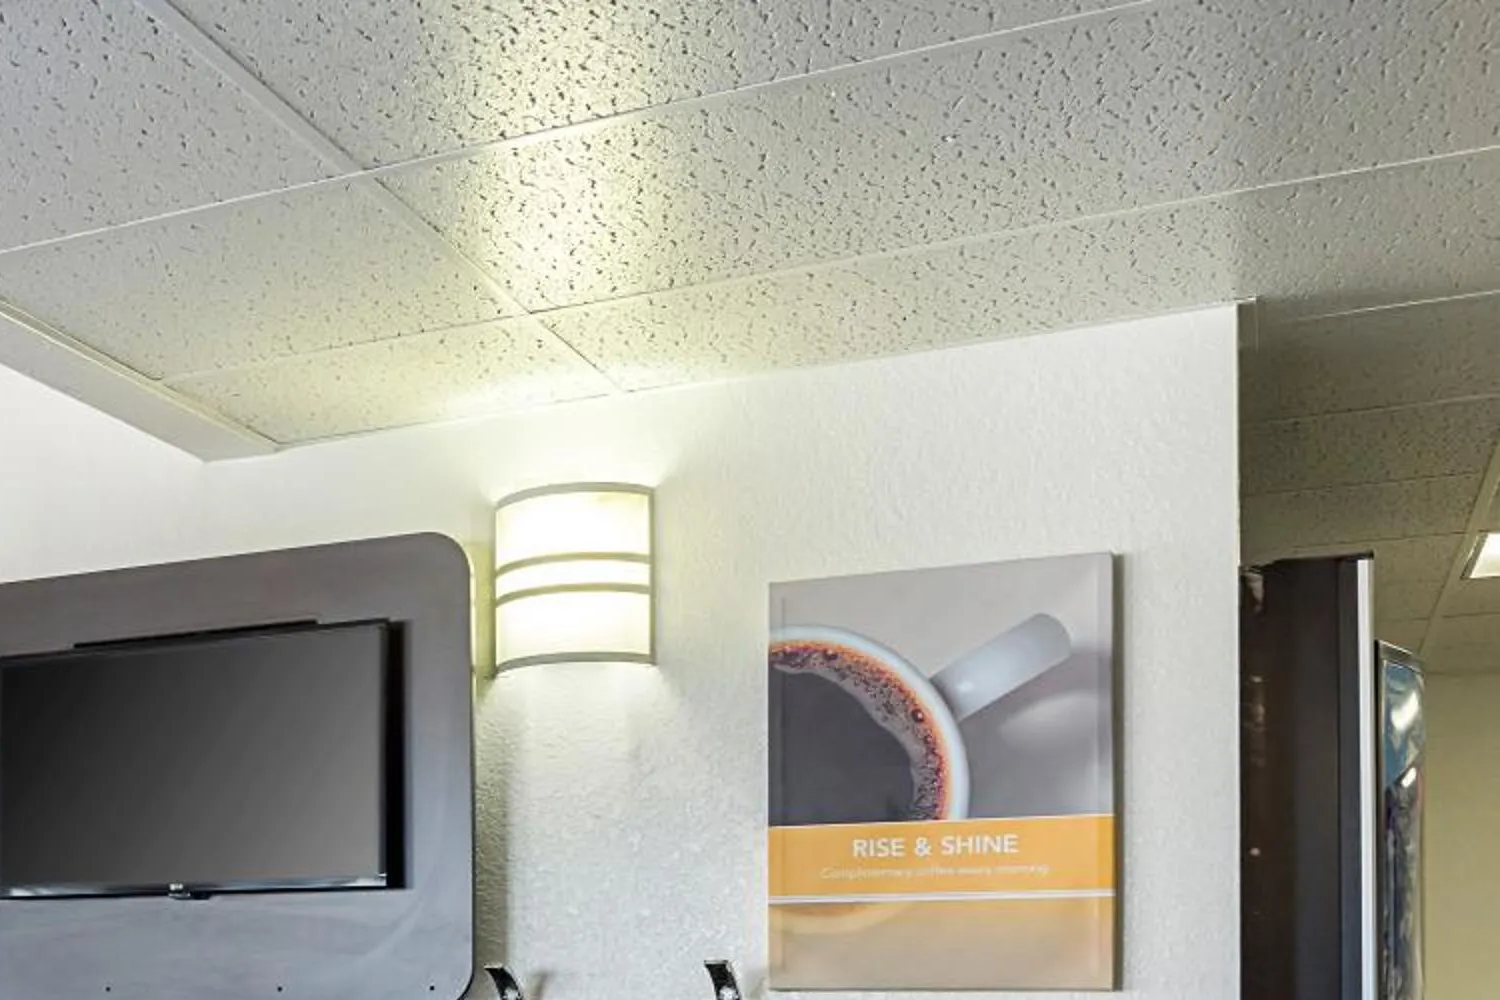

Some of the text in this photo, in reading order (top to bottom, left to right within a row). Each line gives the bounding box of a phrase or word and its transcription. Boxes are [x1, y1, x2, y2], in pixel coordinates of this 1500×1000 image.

[852, 833, 1019, 857] RISE & SHINE
